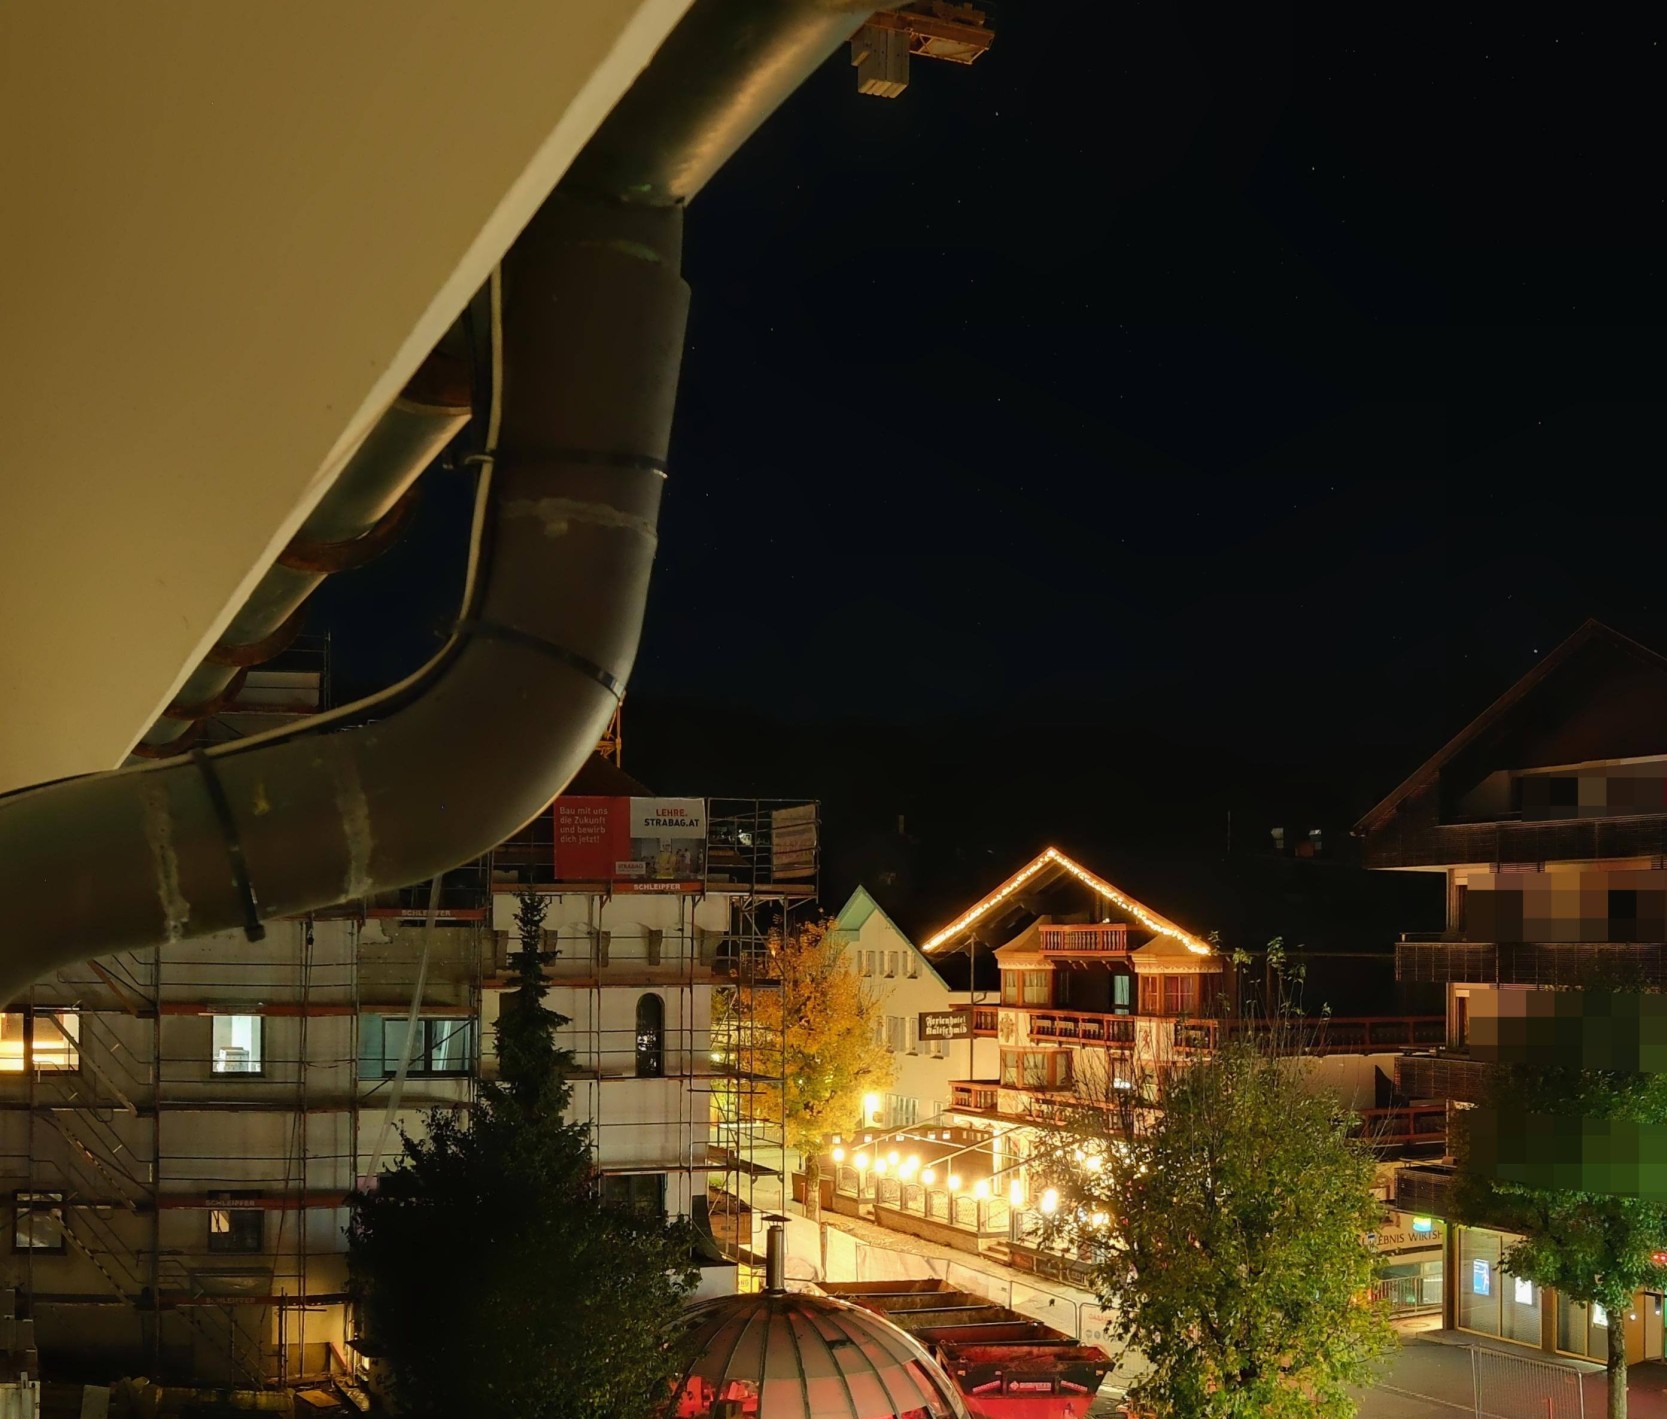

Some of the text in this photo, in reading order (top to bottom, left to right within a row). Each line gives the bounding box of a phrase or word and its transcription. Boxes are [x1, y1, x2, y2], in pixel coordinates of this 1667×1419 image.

[559, 806, 608, 816] Bau mit uns
[655, 808, 688, 818] LEHRE.
[559, 816, 606, 825] die Zukunft
[644, 818, 700, 828] STRABAG.AT
[559, 825, 606, 834] und bewirb
[559, 834, 577, 844] dich
[633, 883, 681, 891] SCHLEIPFER
[401, 909, 451, 917] SCHLEFER
